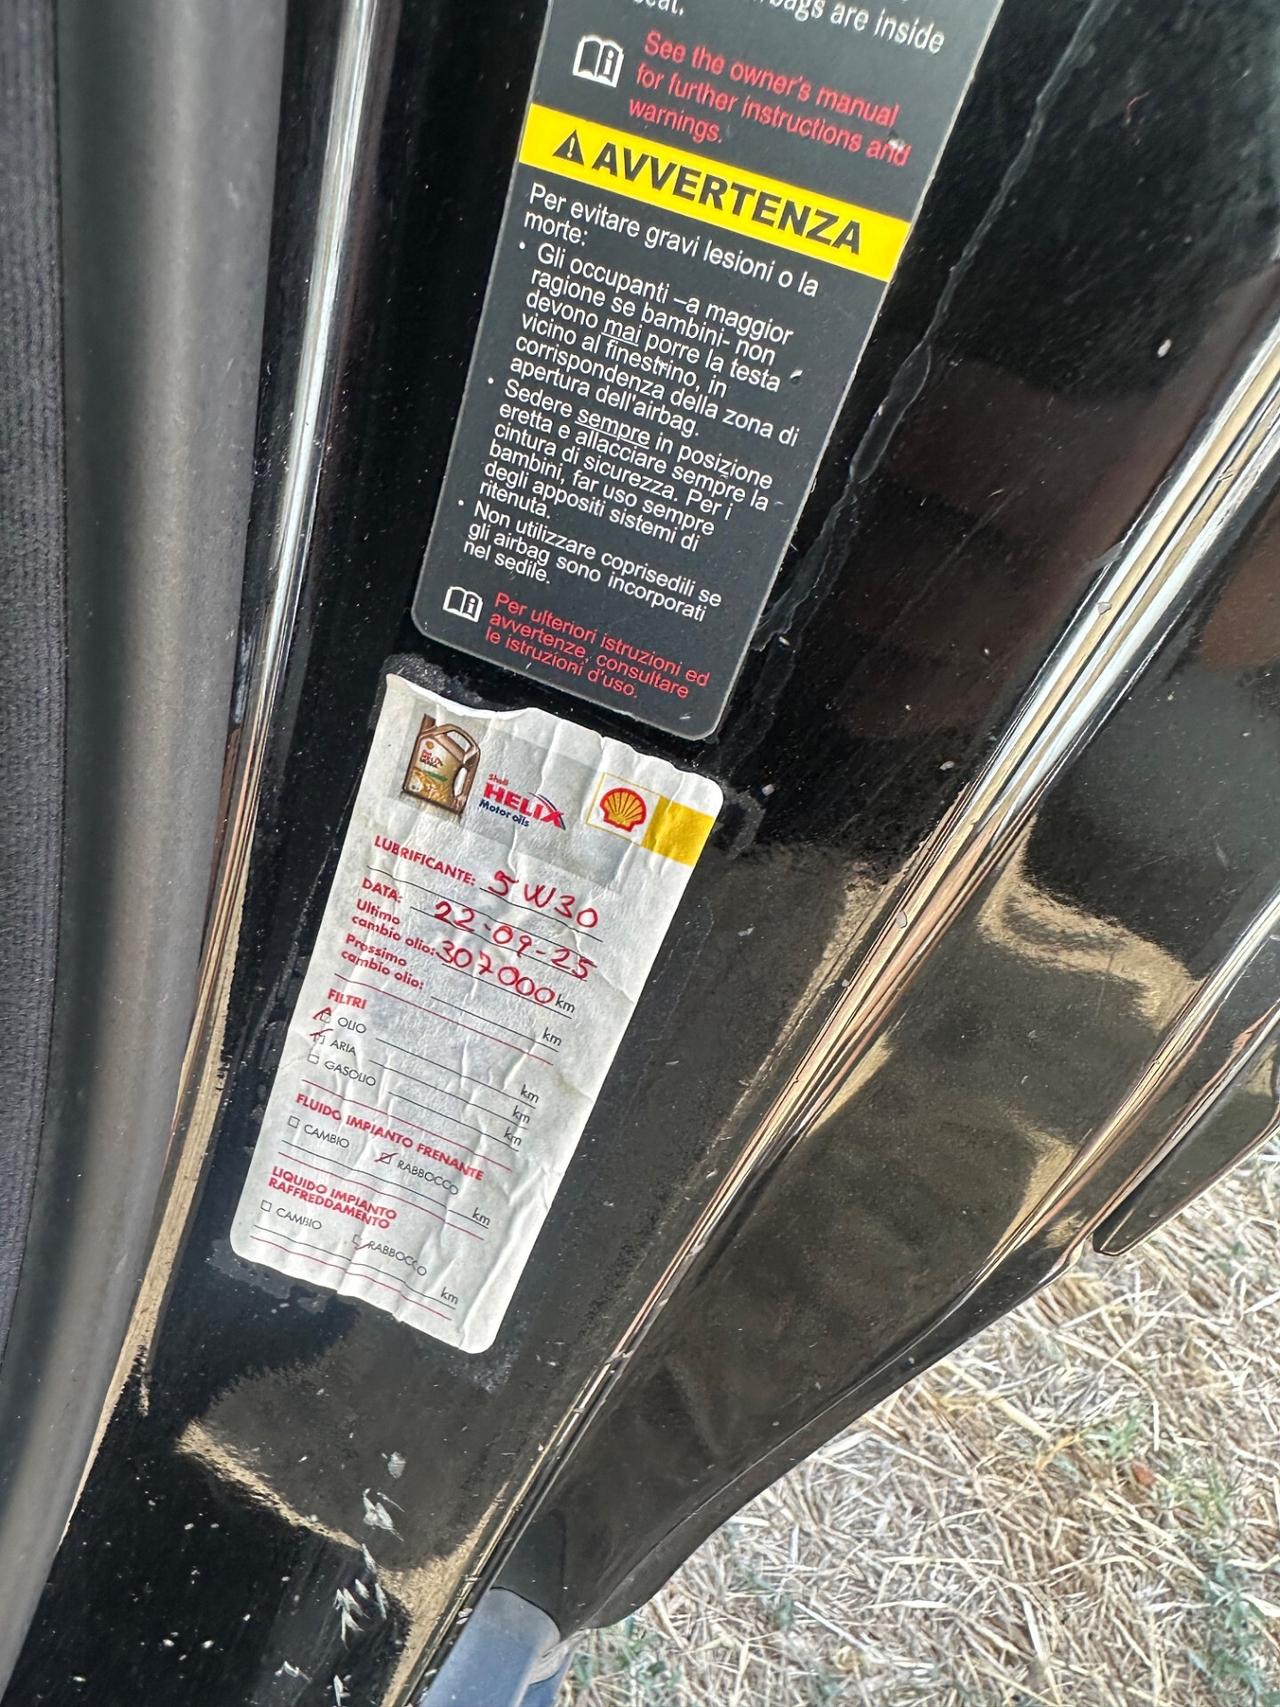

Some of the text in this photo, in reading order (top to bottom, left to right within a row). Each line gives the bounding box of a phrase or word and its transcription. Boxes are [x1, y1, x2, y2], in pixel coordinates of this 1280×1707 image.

[830, 3, 869, 31] are
[874, 15, 944, 53] inside
[629, 99, 723, 144] warnings.
[637, 63, 912, 167] for further instructions and
[645, 31, 899, 126] See the owner's manual
[524, 211, 588, 246] morte:
[529, 182, 818, 297] Per evitare gravi lesioni o la
[592, 142, 861, 255] AVVERTENZA
[531, 269, 605, 307] ragione
[611, 297, 635, 317] se
[735, 339, 776, 366] non
[538, 242, 566, 269] Gli
[570, 258, 670, 304] occupanti
[705, 303, 794, 345] maggior
[522, 313, 727, 398] vicino al finestrino, in
[526, 289, 780, 392] devono mai porre la testa
[505, 378, 773, 489] Sedere sempre in posizione
[510, 357, 699, 438] apertura dell'airbag.
[516, 336, 800, 447] corrispondenza della zona di
[479, 481, 550, 519] ritenuta.
[489, 438, 714, 535] bambini, far uso sempre
[494, 422, 733, 520] cintura di sicurezza. Per i
[499, 403, 769, 512] eretta e allacciare sempre la
[484, 460, 700, 552] degli appositi sistemi di
[463, 541, 550, 584] nel sedile.
[468, 523, 707, 622] gli airbag sono incorporati
[474, 500, 722, 607] Non utilizzare coprisedili se
[486, 626, 637, 698] le istruzioni d'uso.
[490, 614, 689, 698] avvertenze, consultare
[495, 592, 710, 687] Per ulteriori istruzioni ed
[479, 799, 530, 827] Motor oils
[483, 782, 565, 830] HELIX
[362, 877, 403, 903] DATA:
[374, 835, 476, 886] LUBRIFICANTE:
[345, 933, 407, 967] Prossimo
[356, 898, 401, 926] Ultimo
[328, 988, 367, 1010] FILTRI
[341, 950, 563, 1047] cambio olio: km
[351, 915, 576, 1013] cambio olio: km
[323, 1059, 522, 1147] GASOLIO km
[329, 1038, 531, 1125] ARIA km
[337, 1016, 540, 1104] OLIO km
[296, 1093, 484, 1181] FLUIDO IMPIANTO FRENANTE
[303, 1123, 491, 1226] CAMBIO RABBOCCO km
[268, 1177, 390, 1230] RAFFREDDAMENTO
[272, 1165, 398, 1221] LIQUIDO IMPIANTO
[276, 1207, 459, 1305] CAMBIO RABBOCCO km
